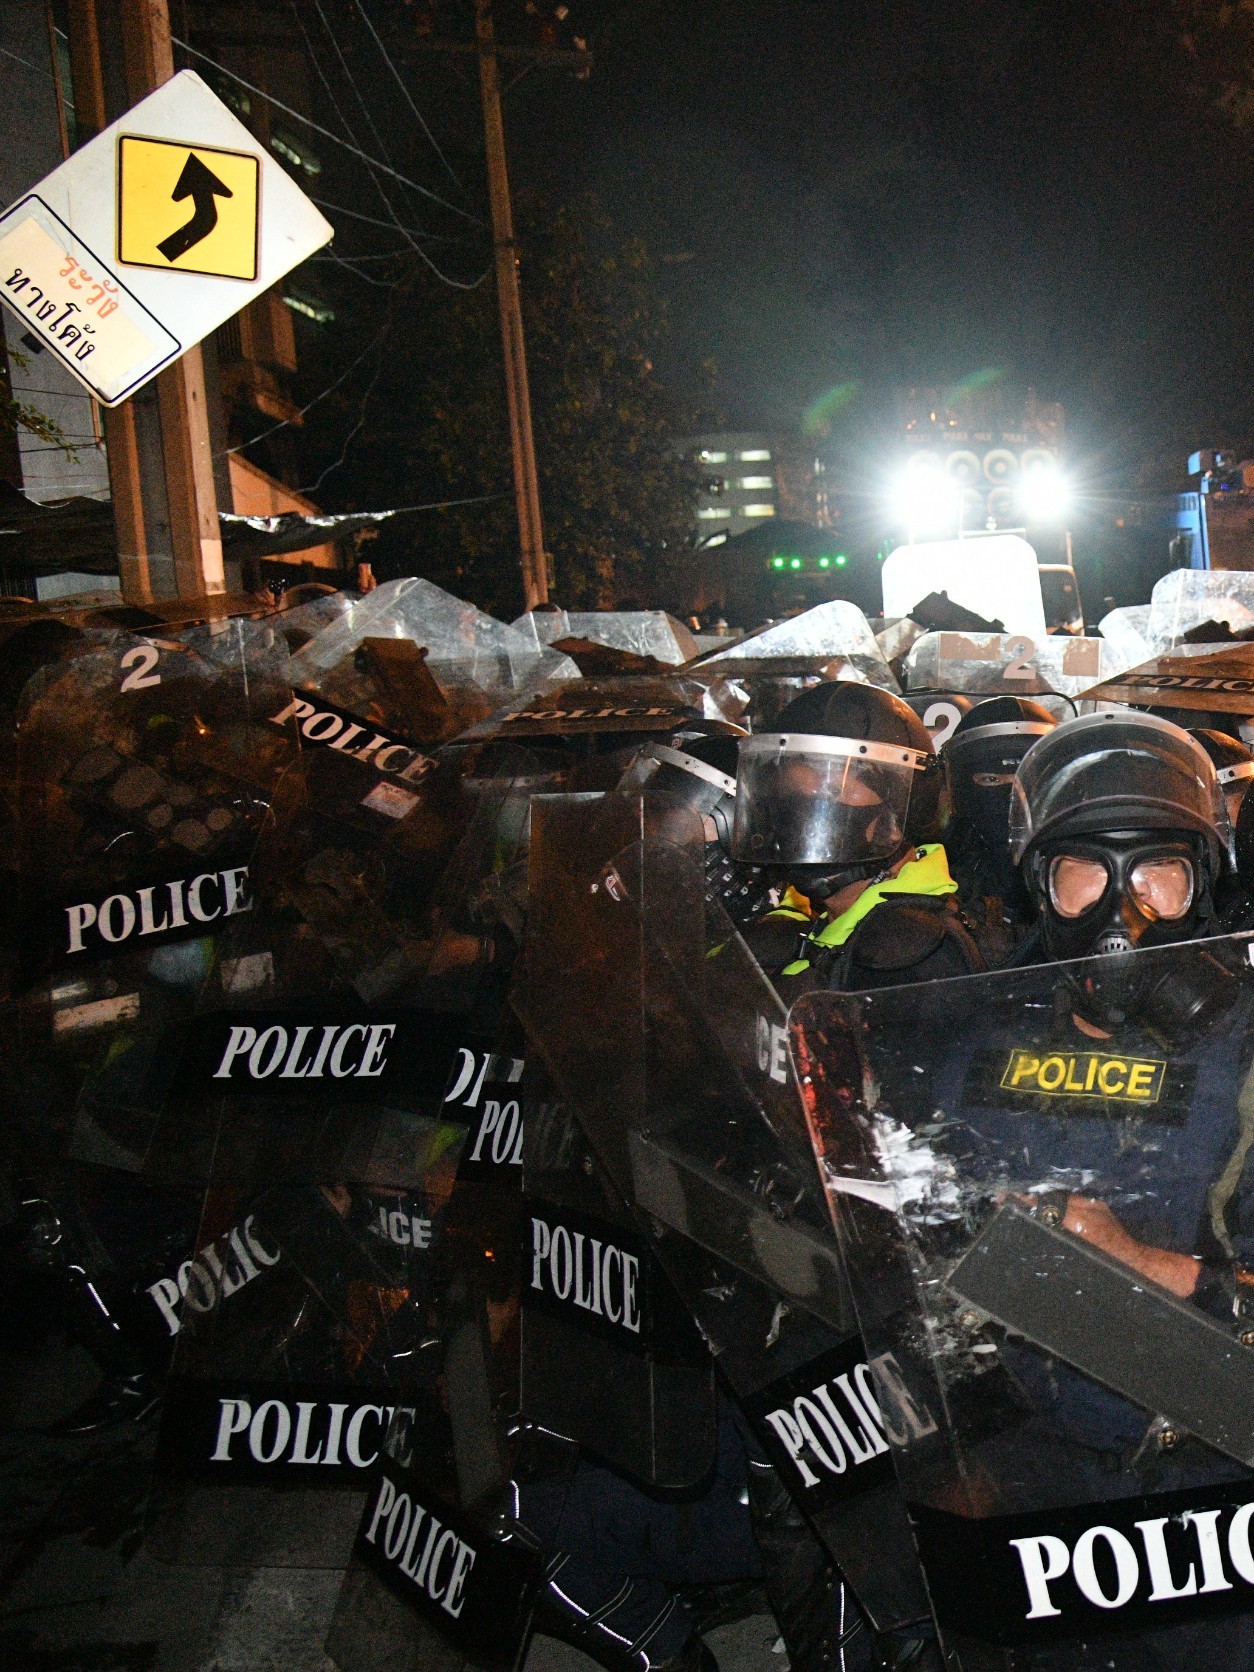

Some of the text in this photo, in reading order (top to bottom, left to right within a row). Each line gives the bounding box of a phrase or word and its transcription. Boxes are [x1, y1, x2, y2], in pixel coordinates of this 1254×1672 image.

[5, 267, 96, 361] ทางโค้ง
[59, 256, 119, 319] ระวัง
[120, 645, 161, 693] 2
[1003, 636, 1037, 680] 2
[268, 698, 441, 785] POLICE
[502, 707, 676, 721] POLICE
[64, 866, 253, 954] POLICE
[213, 1023, 396, 1079] POLICE
[1010, 1055, 1157, 1097] POLICE
[530, 1217, 642, 1333] POLICE
[209, 1398, 417, 1468] POLICE
[764, 1351, 940, 1489] POLICE
[365, 1475, 477, 1619] POLICE
